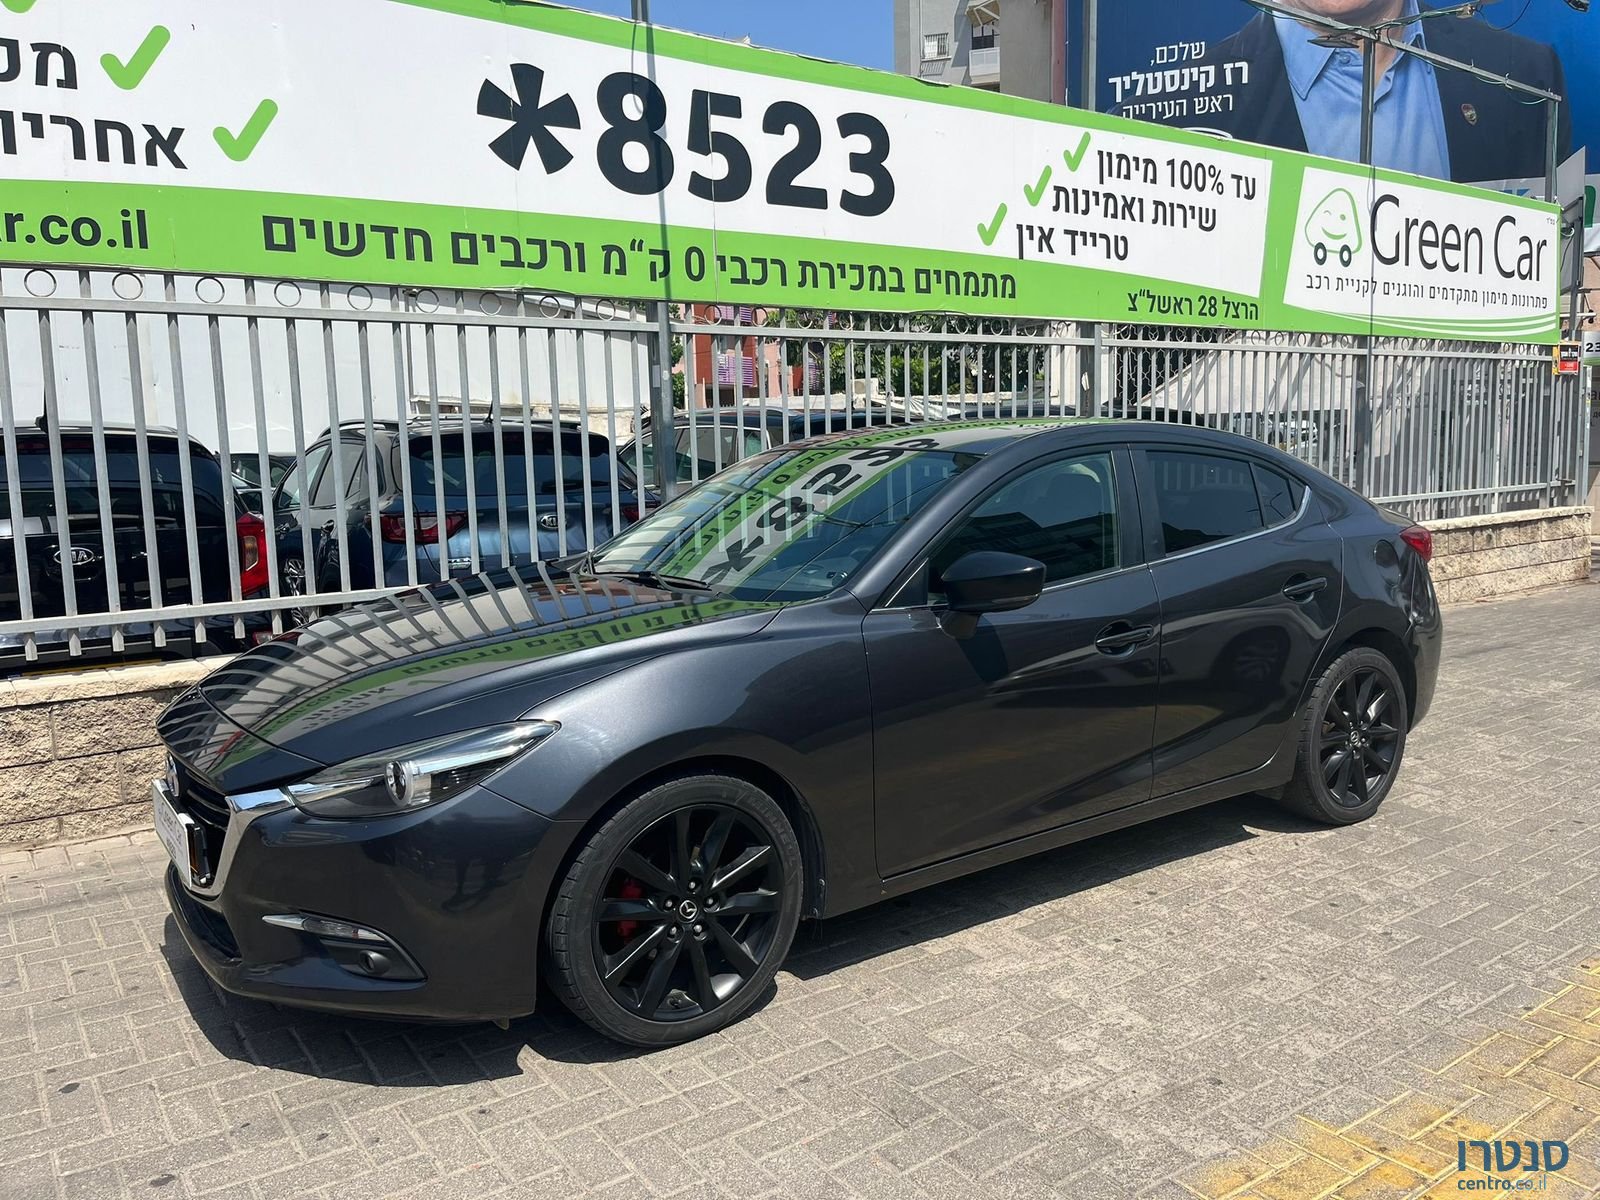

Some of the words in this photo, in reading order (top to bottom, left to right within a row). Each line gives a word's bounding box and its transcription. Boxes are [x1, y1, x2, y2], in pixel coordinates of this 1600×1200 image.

[1150, 41, 1205, 65] שלכם,
[1109, 65, 1215, 102] קינסטליך
[1224, 61, 1248, 84] רז
[1123, 104, 1187, 120] העירייה
[1195, 94, 1232, 114] ראש
[1098, 150, 1157, 184] מימון
[1167, 159, 1223, 195] 100%
[1231, 174, 1255, 200] עד
[1053, 186, 1143, 222] ואמינות
[1152, 200, 1216, 232] שירות
[1, 208, 149, 250] r.co.il
[263, 215, 432, 262] חדשים
[1017, 224, 1054, 260] אין
[1371, 193, 1483, 276] Green
[1494, 216, 1547, 281] Car
[451, 232, 585, 272] ורכבים
[1064, 229, 1128, 260] טרייד
[685, 246, 705, 281] 0
[716, 255, 787, 286] רכבי
[798, 261, 905, 292] במכירת
[915, 268, 1015, 298] מתמחים
[1306, 275, 1329, 290] רכב
[1336, 275, 1377, 297] לקניית
[1383, 282, 1423, 297] והוגנים
[1430, 286, 1477, 304] מתקדמים
[1198, 295, 1217, 317] 28
[1222, 296, 1258, 320] הרצל
[1482, 290, 1508, 308] מימון
[1512, 294, 1547, 309] פתרונות
